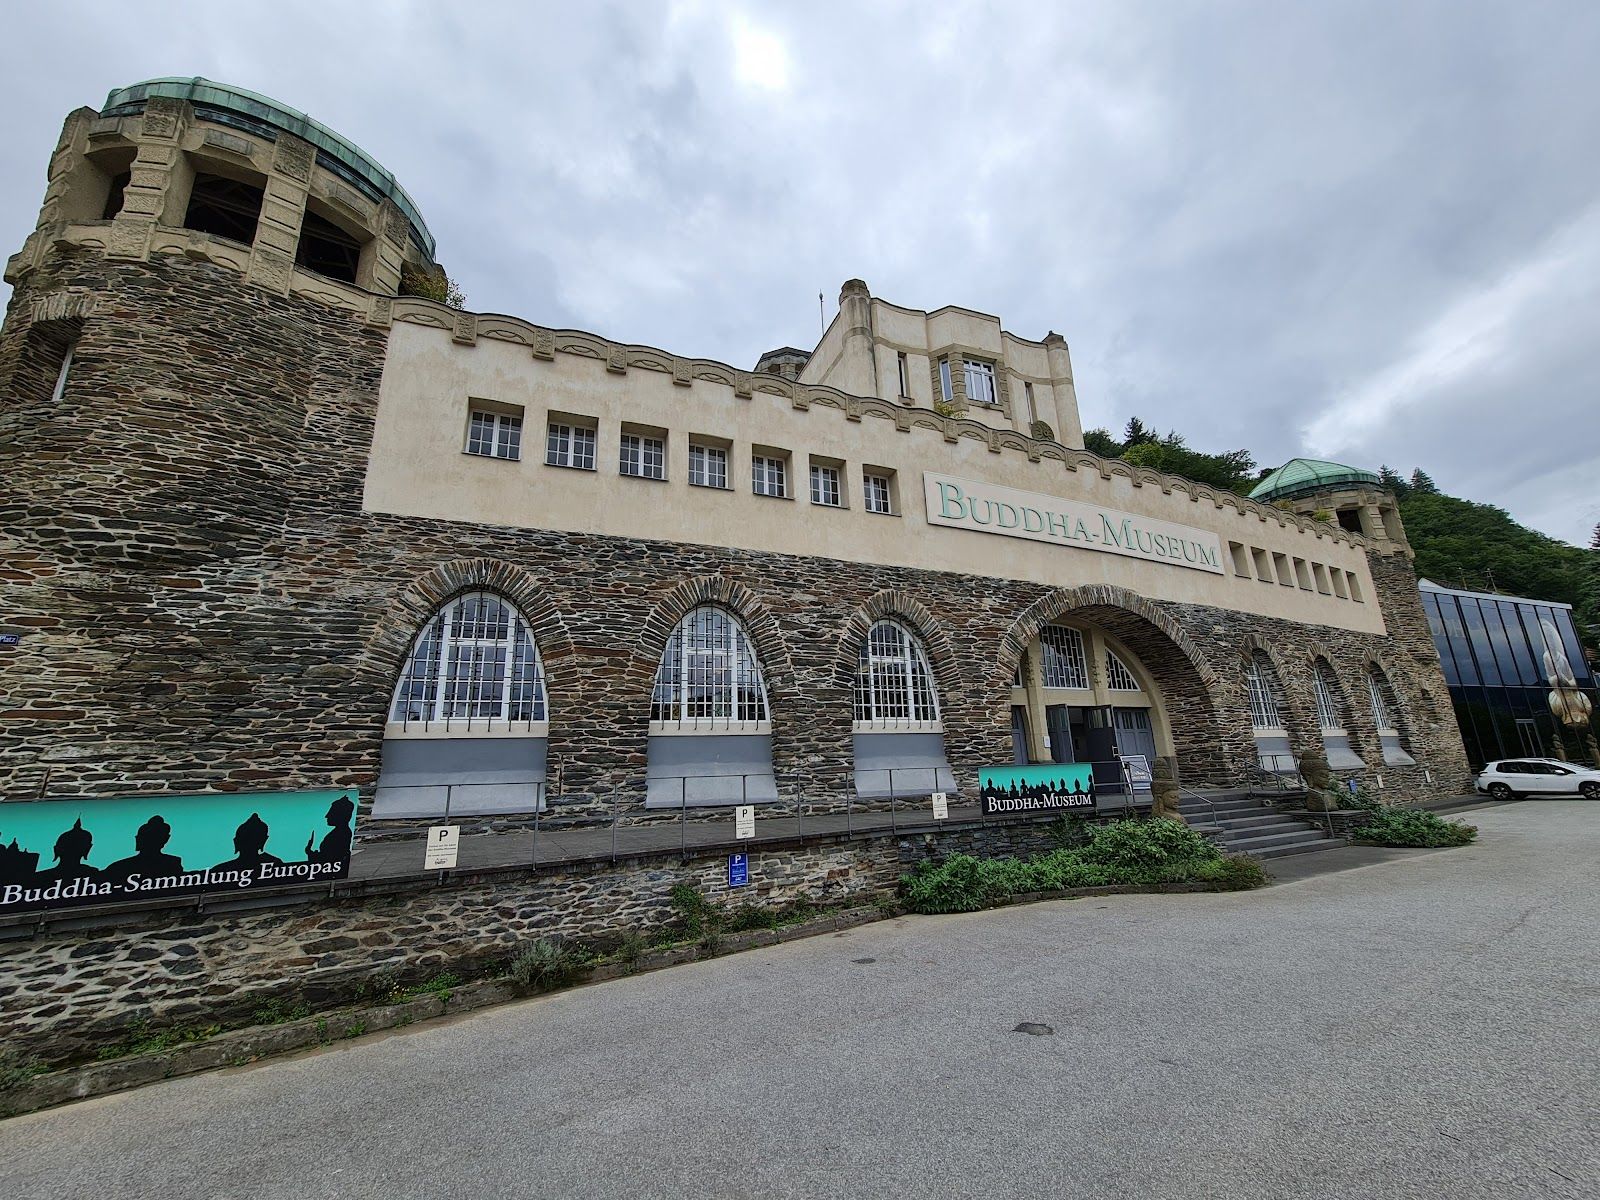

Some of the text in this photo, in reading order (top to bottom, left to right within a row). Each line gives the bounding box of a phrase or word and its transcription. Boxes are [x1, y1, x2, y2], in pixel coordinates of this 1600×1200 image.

[742, 809, 748, 818] P
[439, 830, 448, 841] P
[735, 854, 742, 864] P
[0, 858, 342, 905] Buddha-Sammlung Europas
